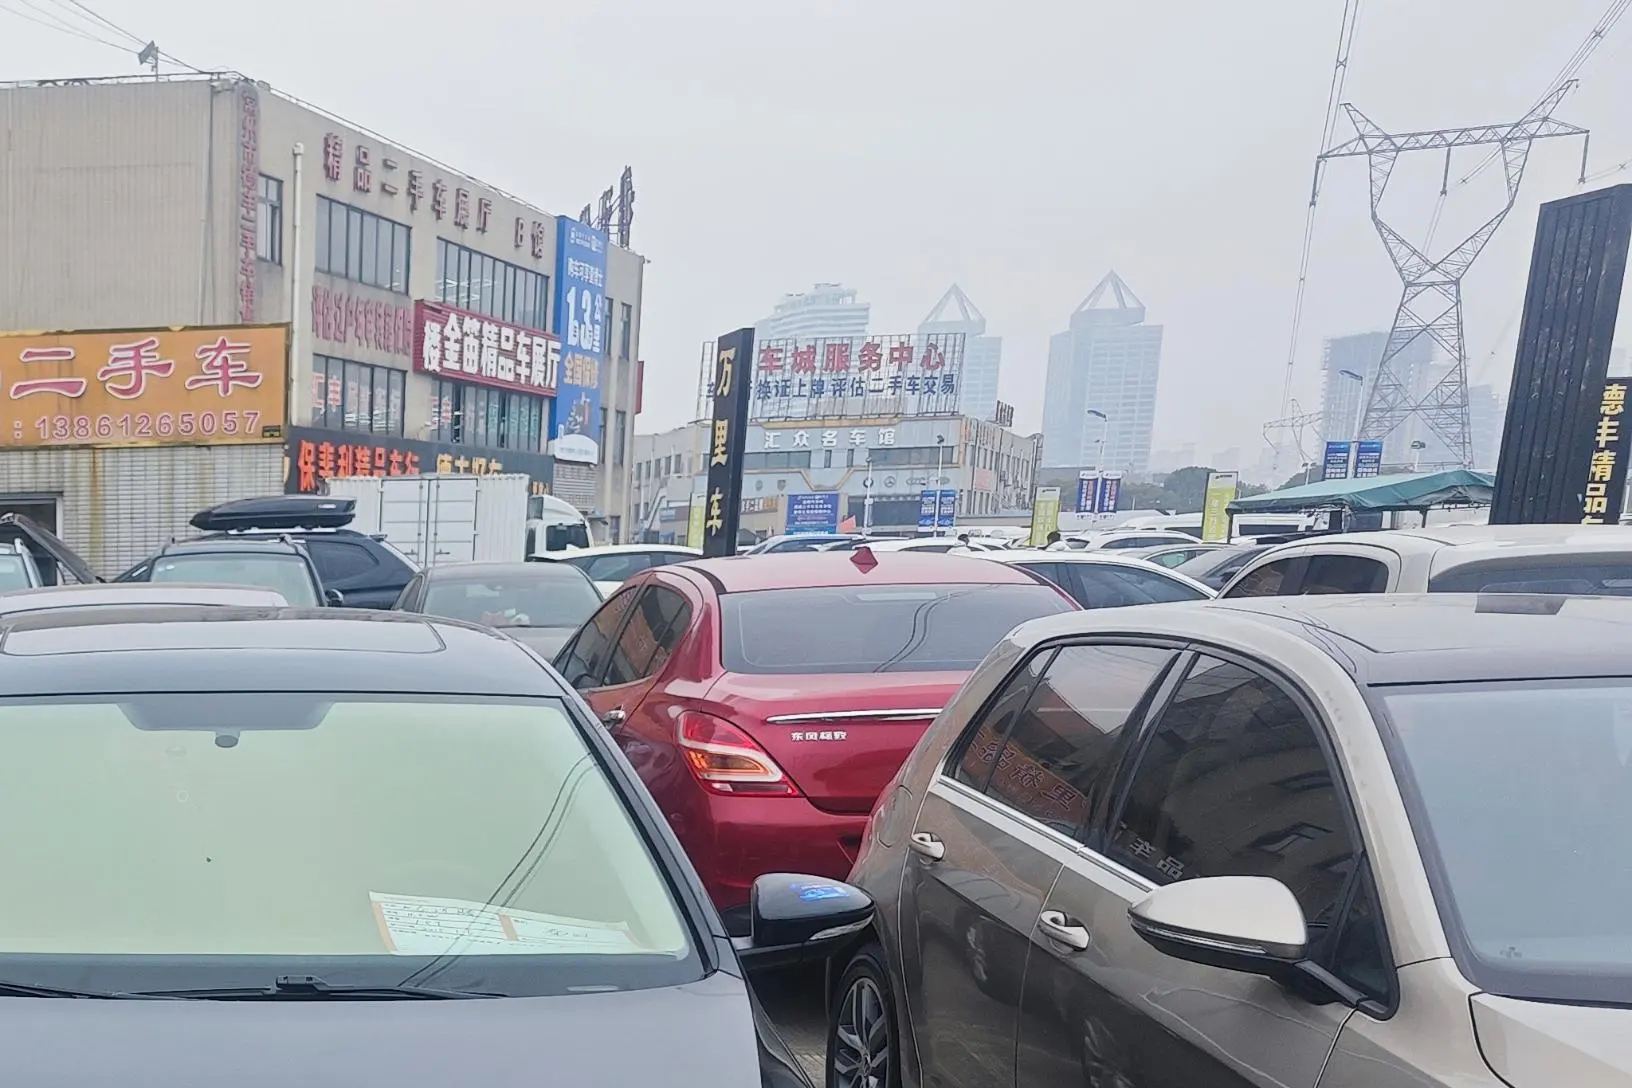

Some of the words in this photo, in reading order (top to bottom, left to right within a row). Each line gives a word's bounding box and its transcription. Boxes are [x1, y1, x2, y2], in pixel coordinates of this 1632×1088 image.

[759, 341, 945, 374] 车城服务中心
[36, 411, 261, 440] 13861265057
[764, 429, 895, 449] 汇众名车馆
